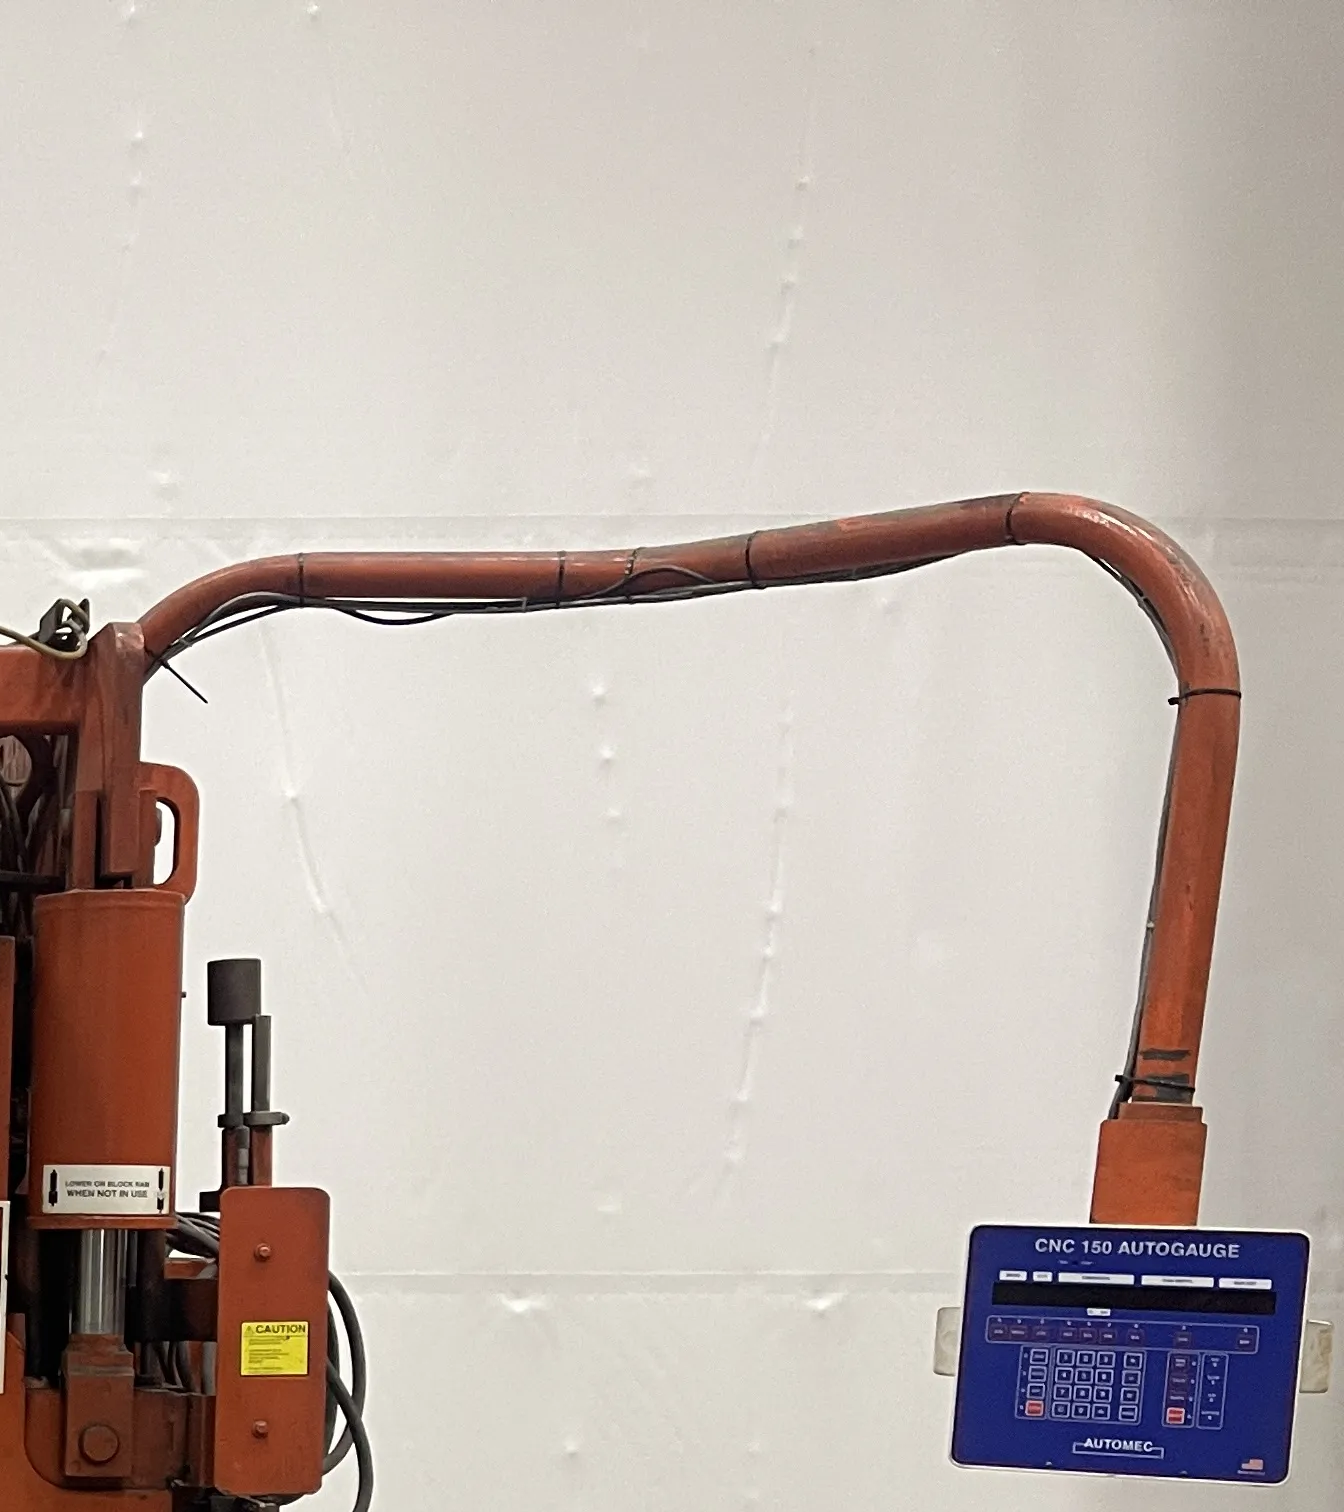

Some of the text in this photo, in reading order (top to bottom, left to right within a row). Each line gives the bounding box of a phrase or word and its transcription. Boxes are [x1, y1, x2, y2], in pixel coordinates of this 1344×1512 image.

[67, 1190, 148, 1198] WHEN NOT IN USE
[1035, 1238, 1241, 1259] CNC 150 AUTOGAUGE
[255, 1324, 306, 1334] CAUTION
[1083, 1437, 1154, 1452] AUTOMEC
